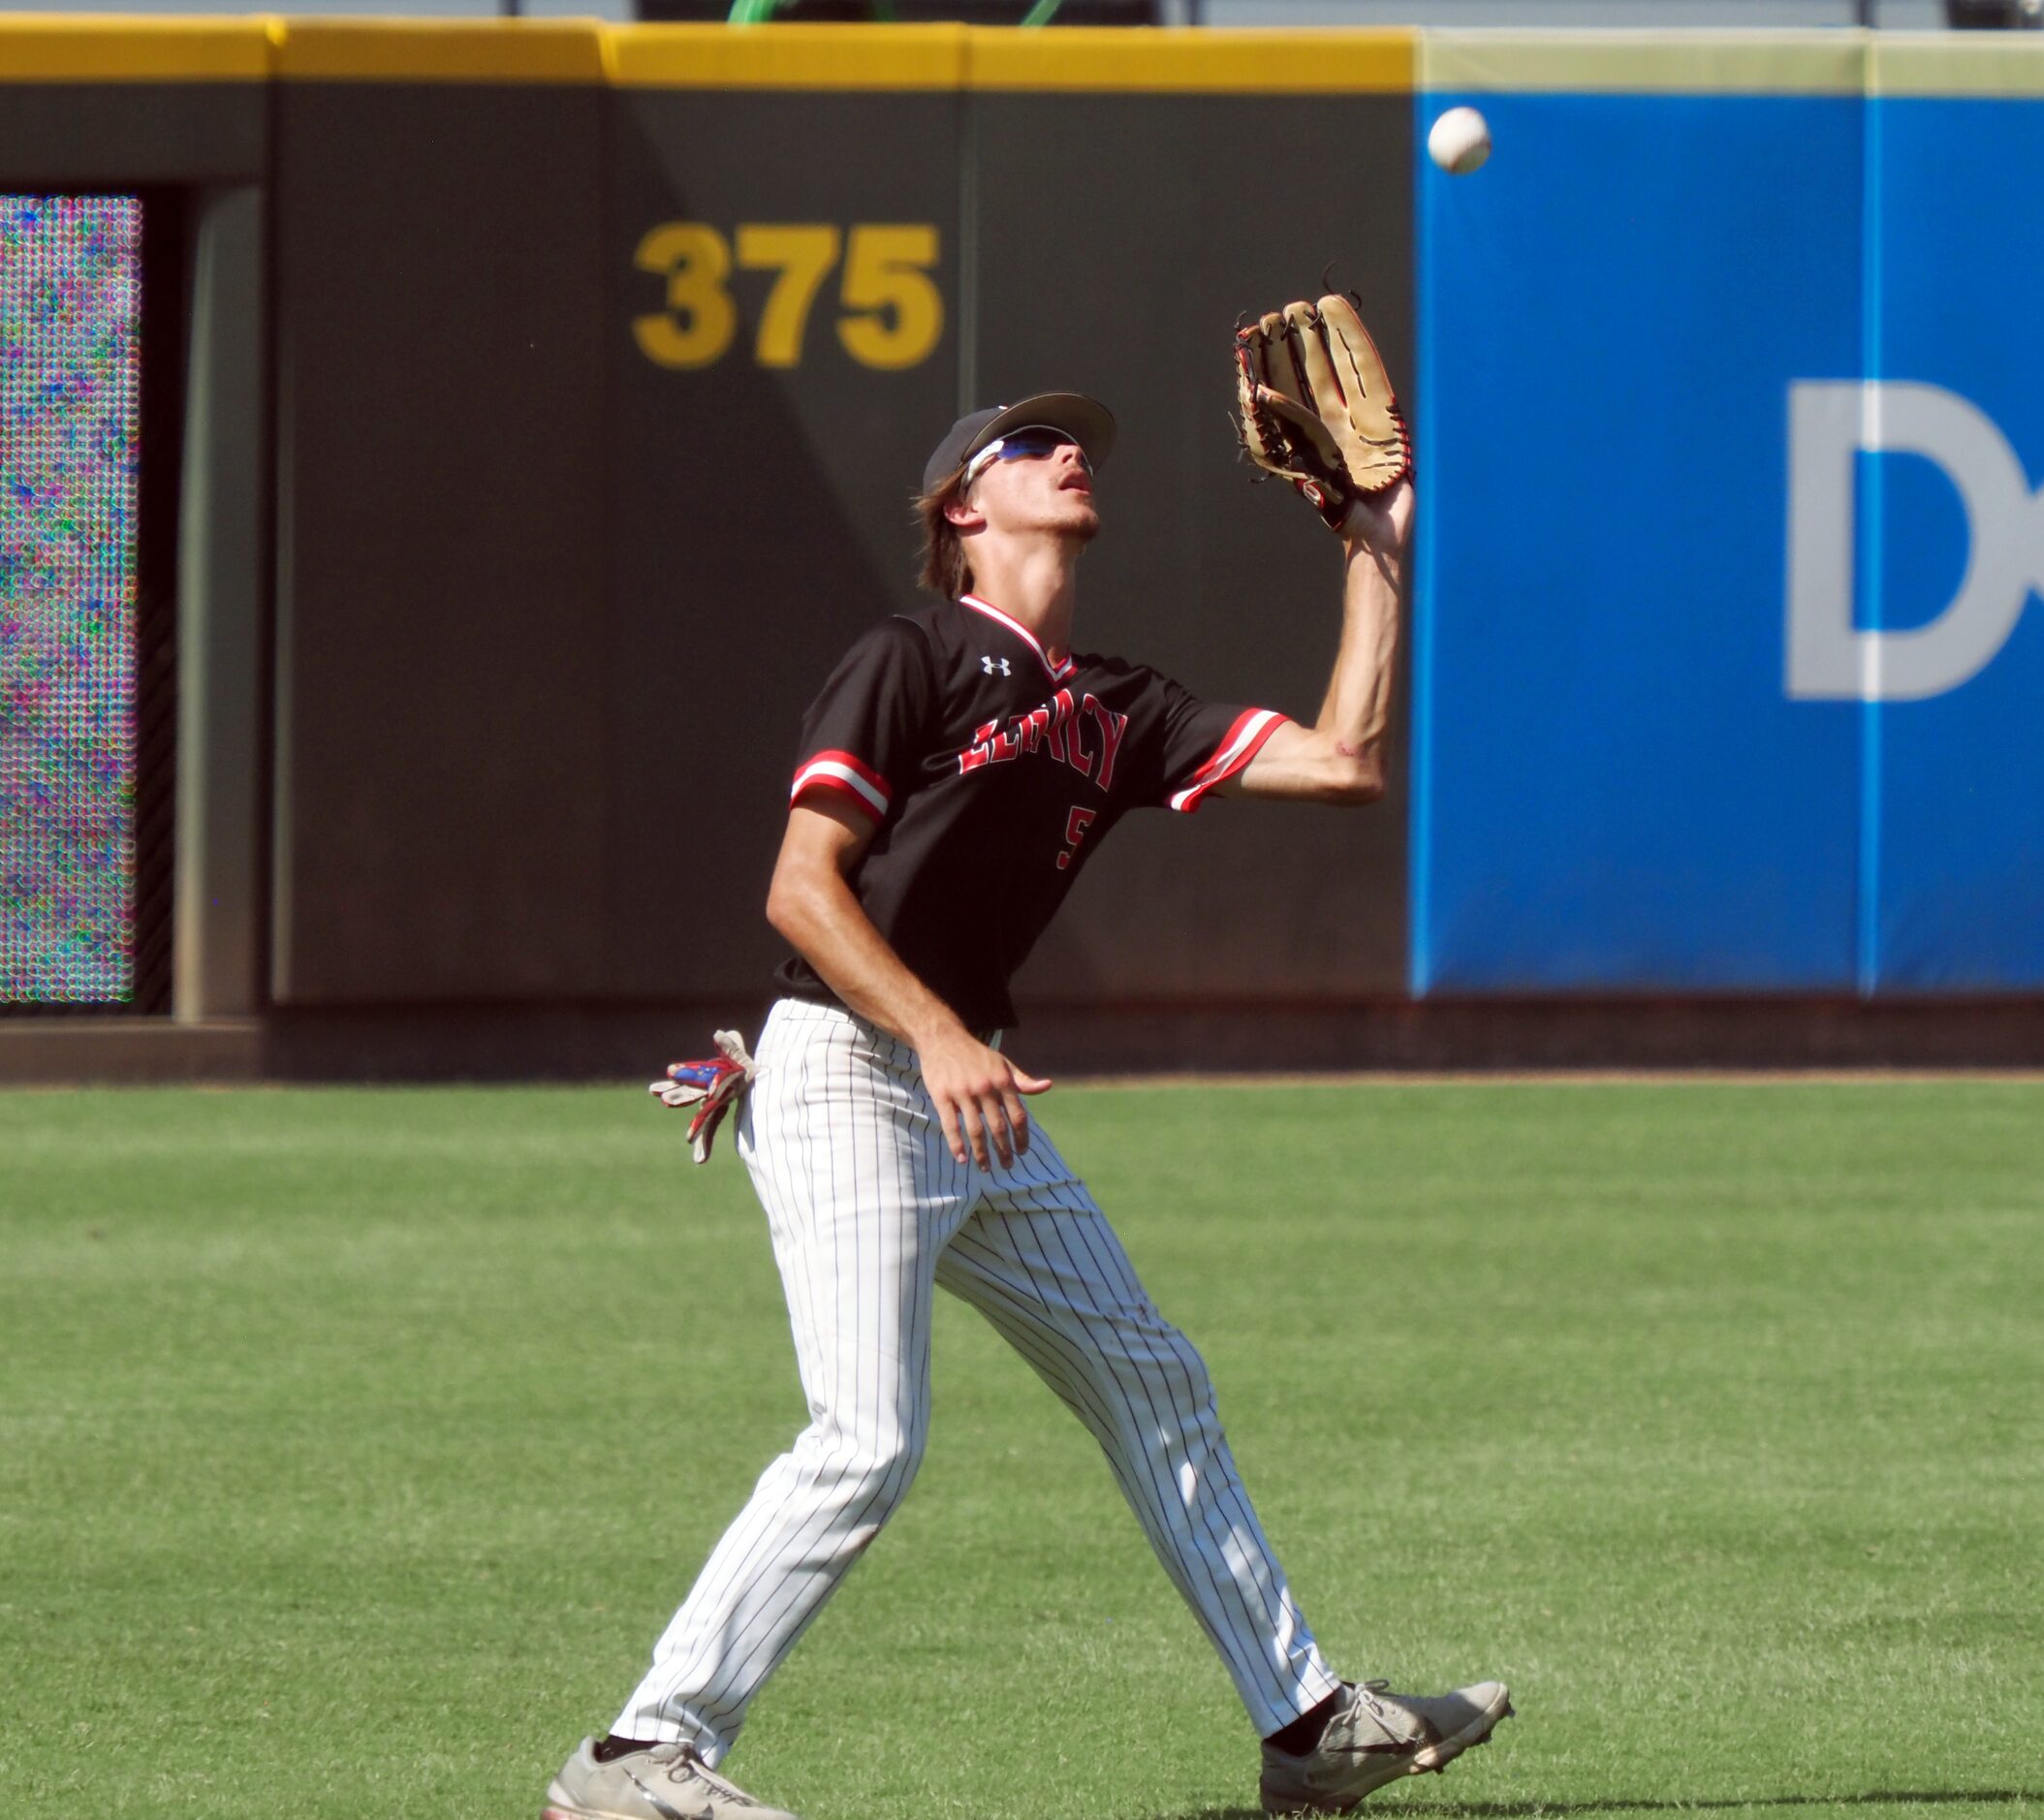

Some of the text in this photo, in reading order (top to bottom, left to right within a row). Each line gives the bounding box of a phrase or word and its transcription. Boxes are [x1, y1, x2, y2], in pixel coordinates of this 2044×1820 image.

[632, 221, 945, 370] 375
[1784, 378, 2044, 702] D
[1056, 805, 1096, 869] 5
